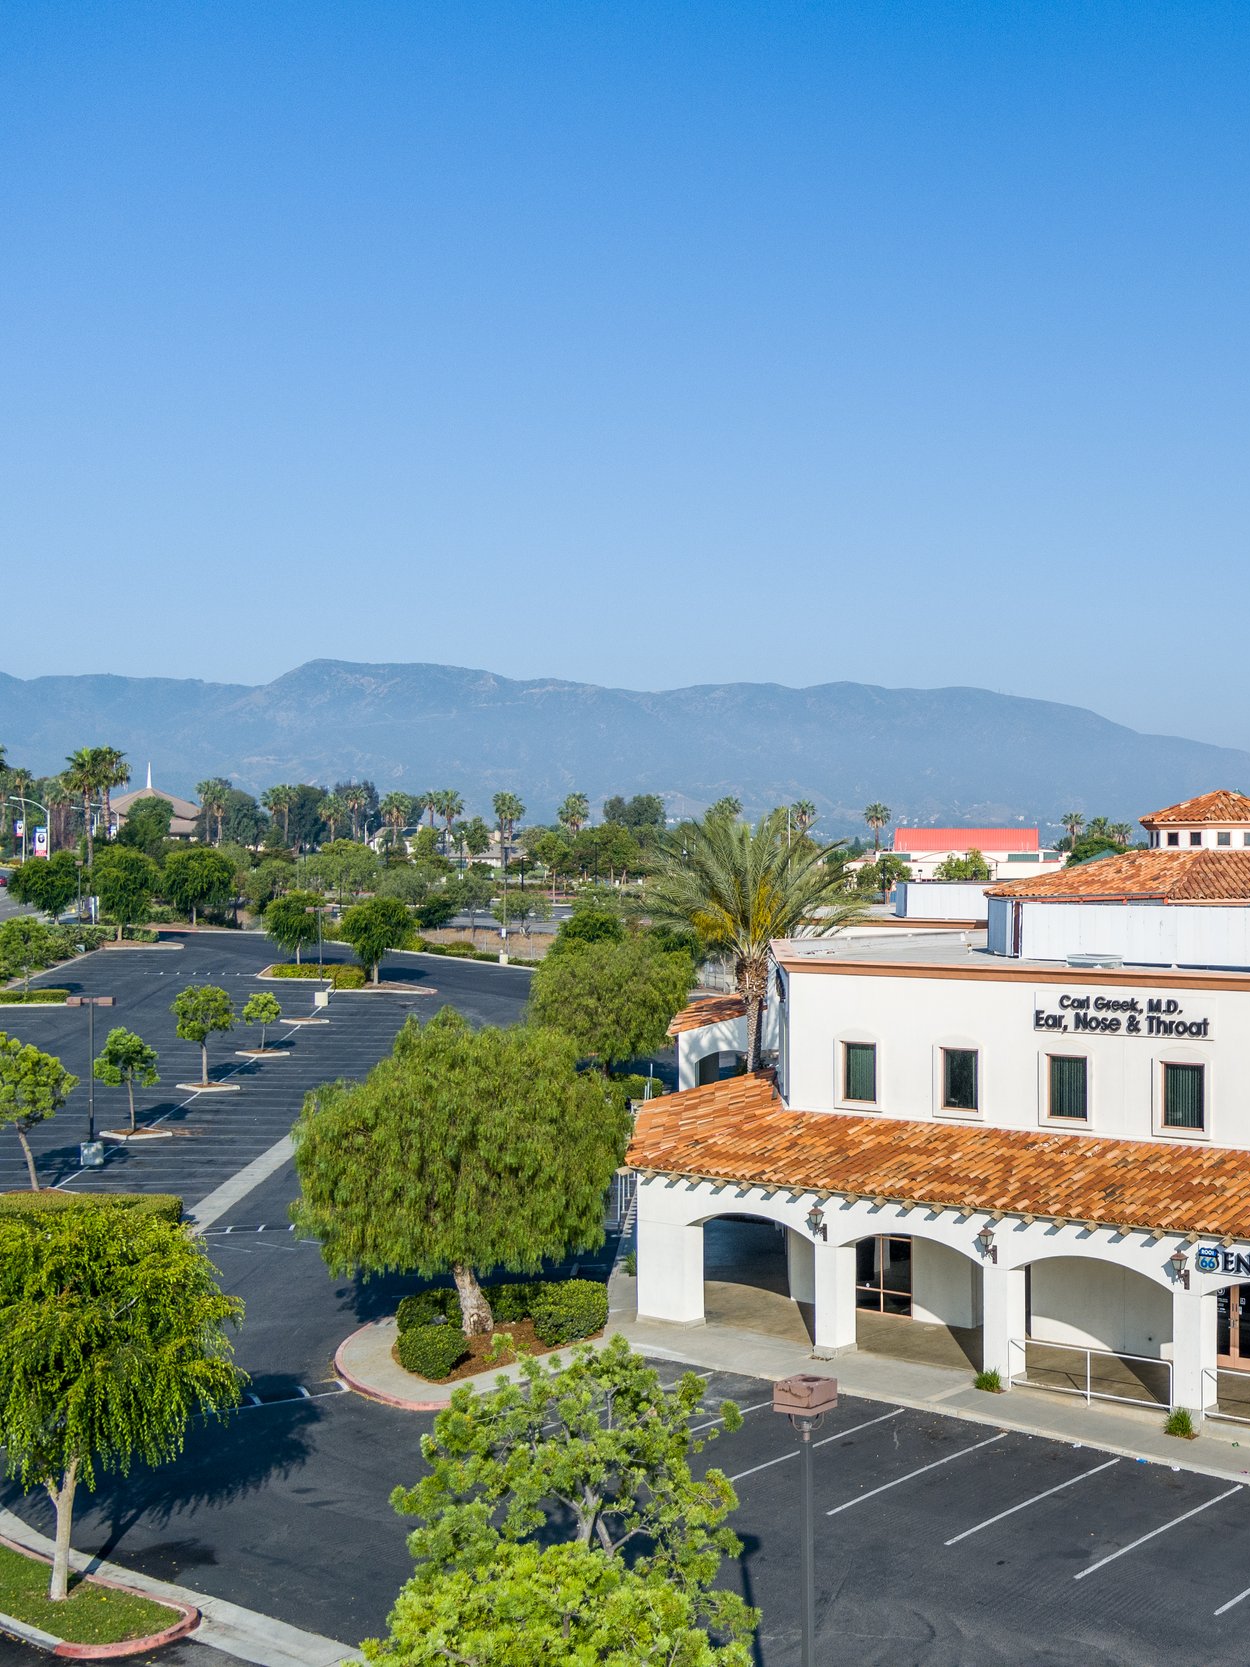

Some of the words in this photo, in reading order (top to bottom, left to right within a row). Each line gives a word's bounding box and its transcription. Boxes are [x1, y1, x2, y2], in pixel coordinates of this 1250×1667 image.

[1059, 995, 1090, 1011] Carl
[1093, 996, 1143, 1015] Greek,
[1147, 998, 1183, 1015] M.D.
[1034, 1010, 1068, 1034] Ear,
[1074, 1012, 1121, 1033] Nose
[1126, 1014, 1141, 1034] &
[1145, 1015, 1209, 1038] Throat
[1200, 1257, 1216, 1269] 66
